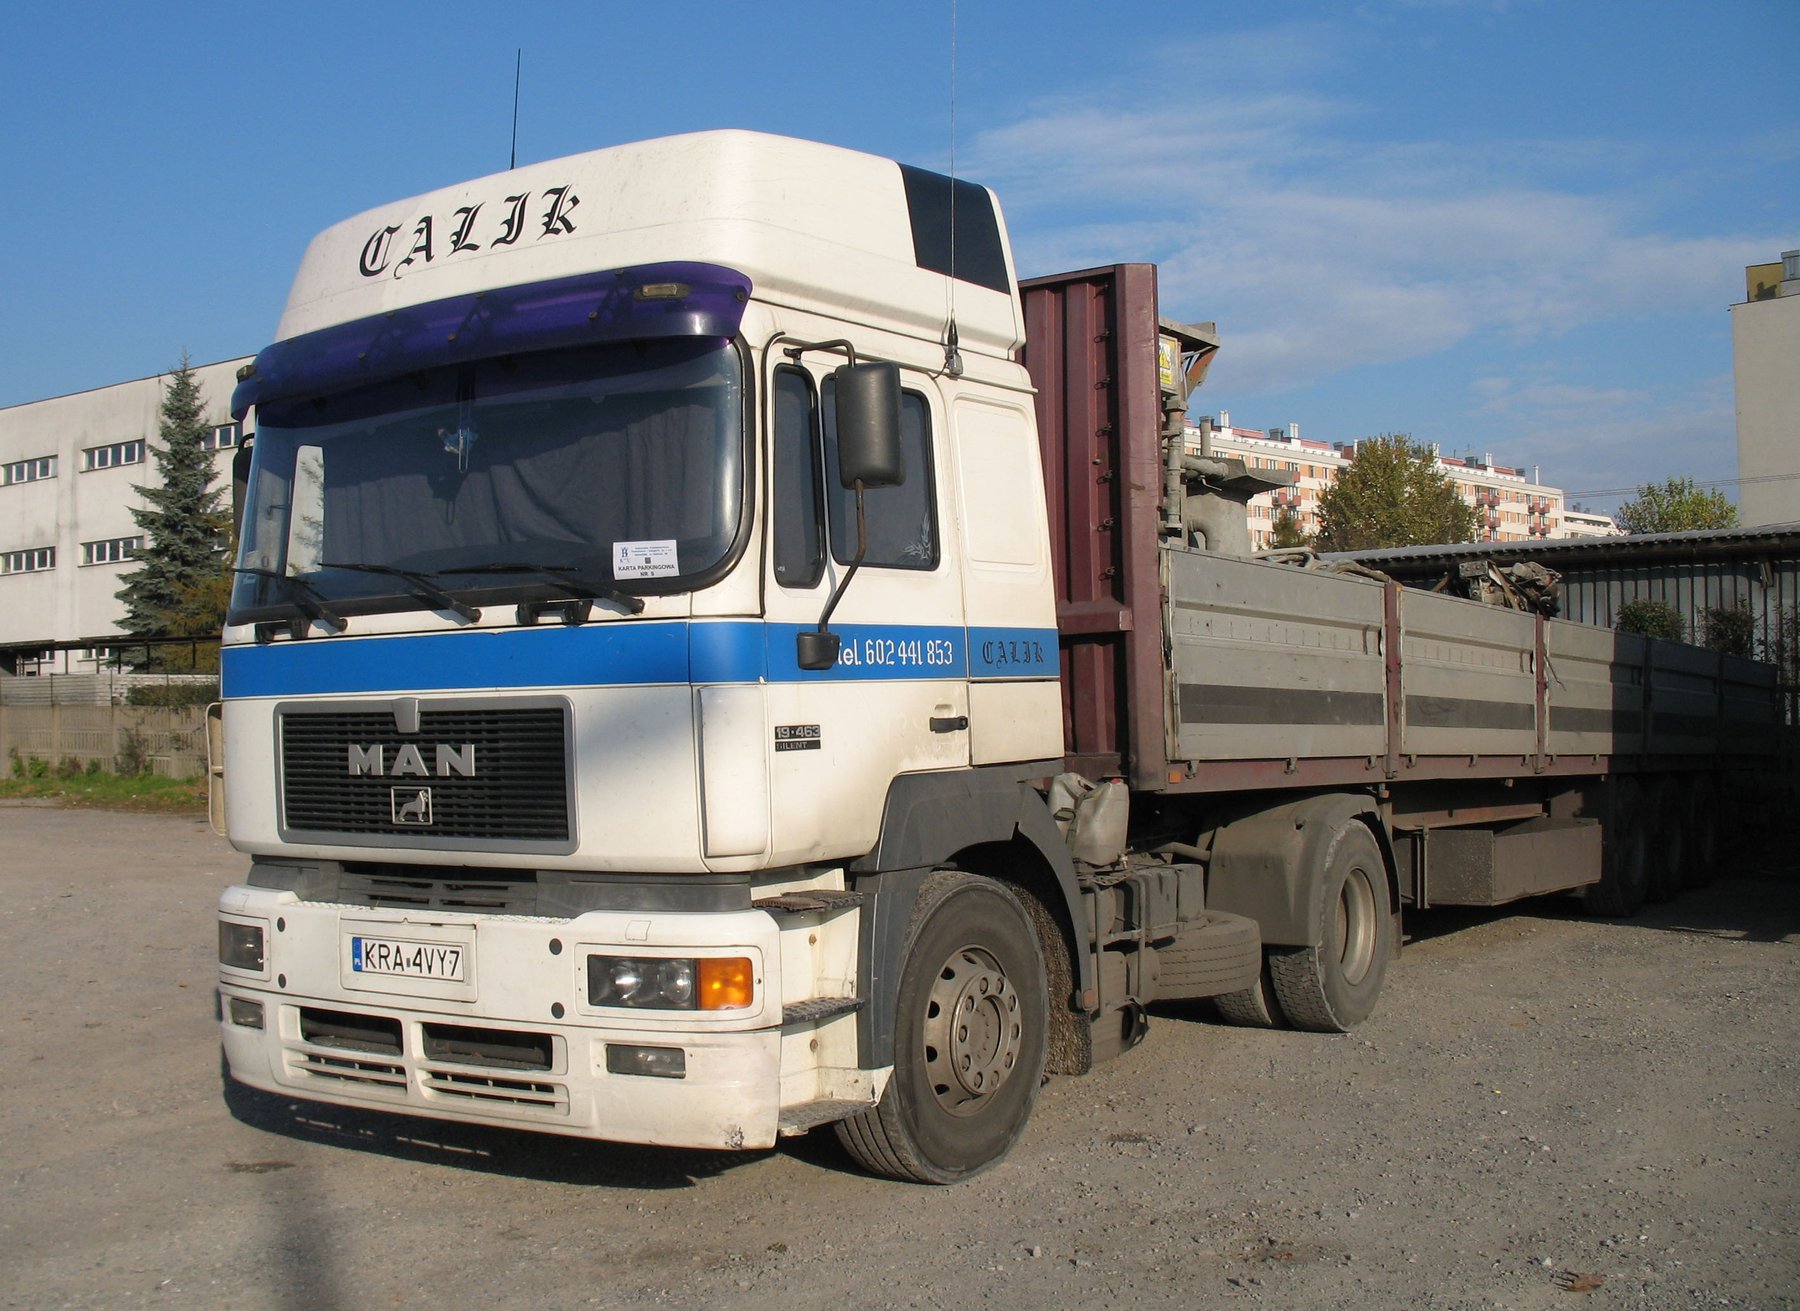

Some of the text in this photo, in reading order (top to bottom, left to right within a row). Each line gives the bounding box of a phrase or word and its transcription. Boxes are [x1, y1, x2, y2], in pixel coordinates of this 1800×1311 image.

[359, 183, 581, 280] CALIK
[865, 639, 895, 666] 602
[898, 640, 923, 666] 441
[926, 640, 953, 665] 853
[348, 744, 476, 776] MAN
[365, 943, 404, 972] KRA
[412, 947, 460, 976] 4VY7
